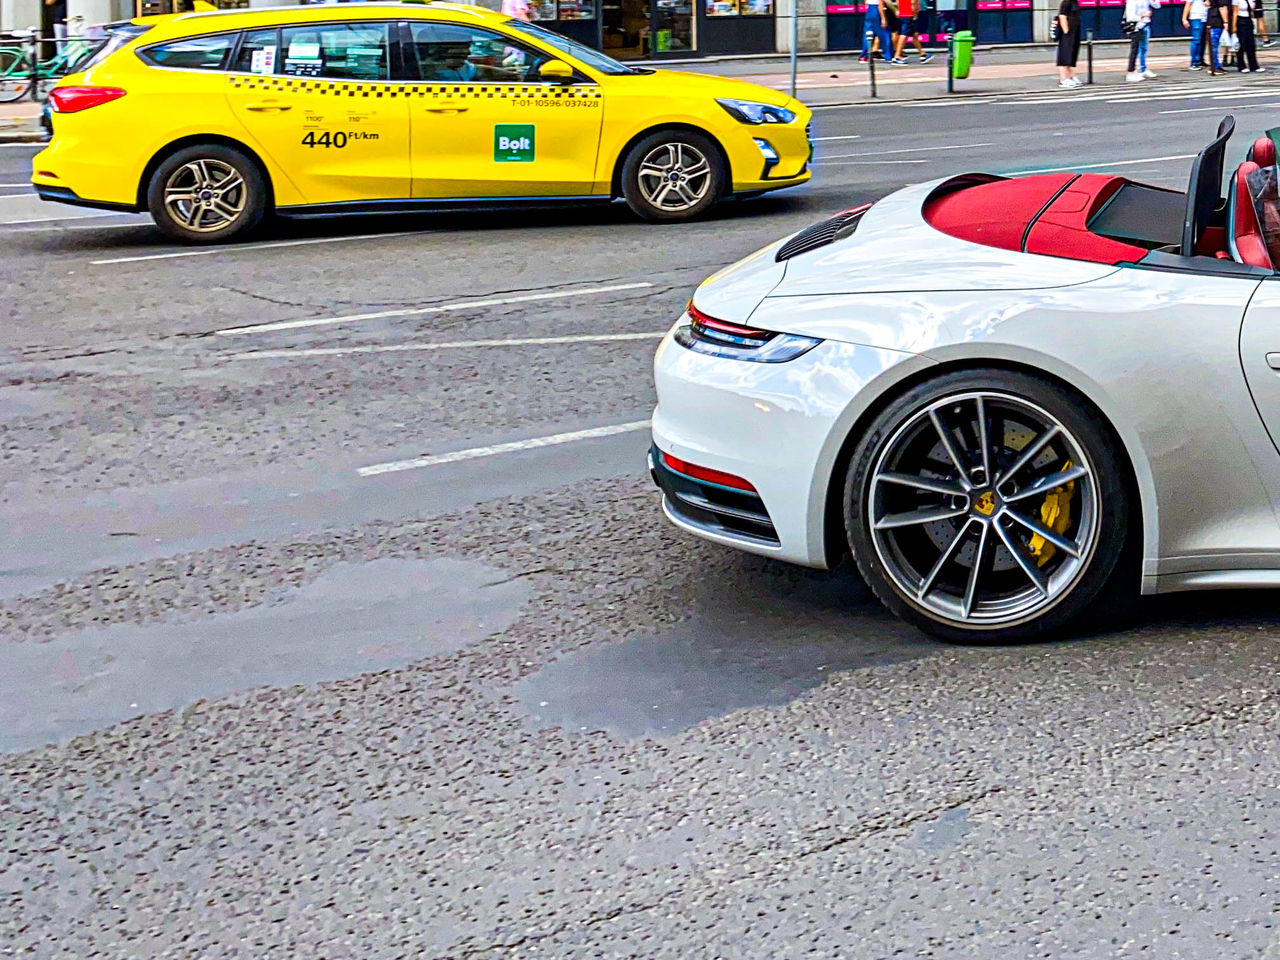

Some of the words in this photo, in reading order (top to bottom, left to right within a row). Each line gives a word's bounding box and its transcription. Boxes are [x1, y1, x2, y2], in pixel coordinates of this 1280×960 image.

[511, 99, 599, 108] T-01-10596/037428
[301, 131, 347, 149] 440
[348, 131, 379, 140] Ft/km
[499, 136, 531, 150] Bolt
